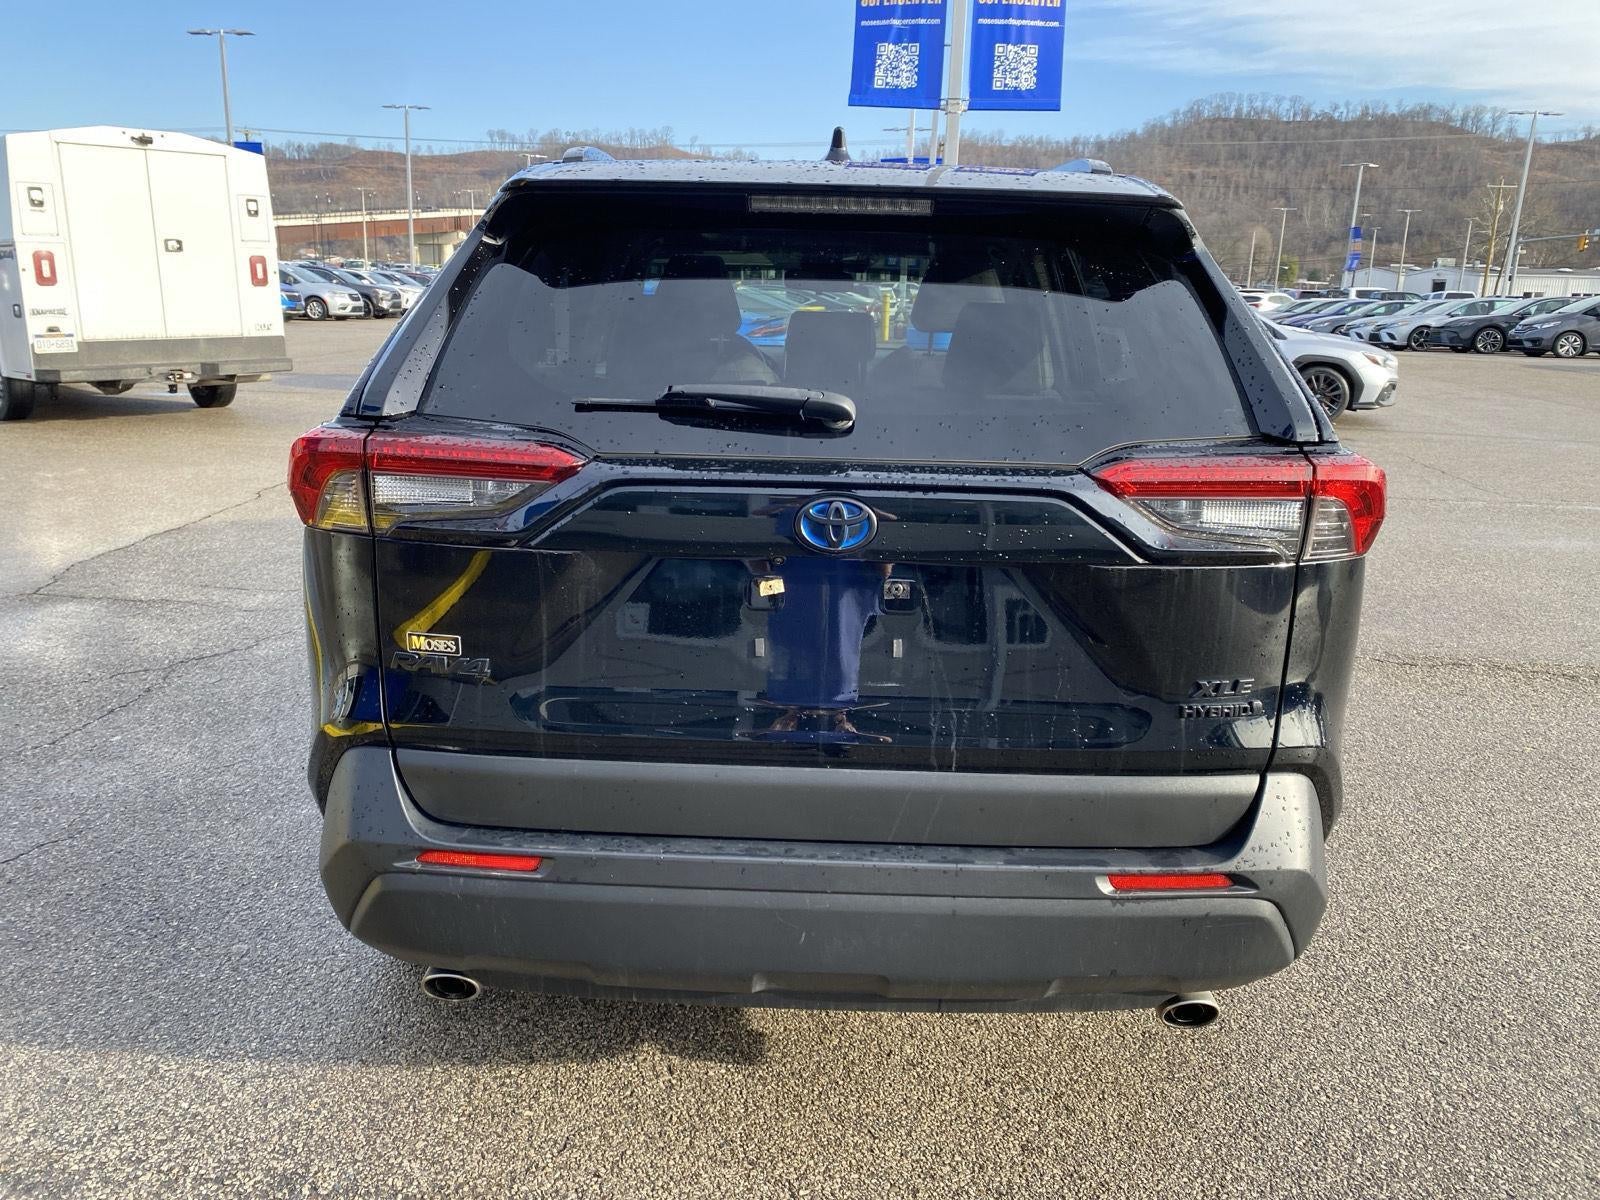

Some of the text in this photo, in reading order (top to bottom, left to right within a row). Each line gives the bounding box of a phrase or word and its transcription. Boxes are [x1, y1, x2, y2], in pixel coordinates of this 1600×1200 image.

[861, 18, 941, 26] mosesusedsupercenter.com
[978, 17, 1060, 27] mosesusedsupercenter.com
[391, 651, 492, 677] RAV4
[1189, 678, 1255, 698] XLE
[1180, 702, 1253, 718] HYBRID
